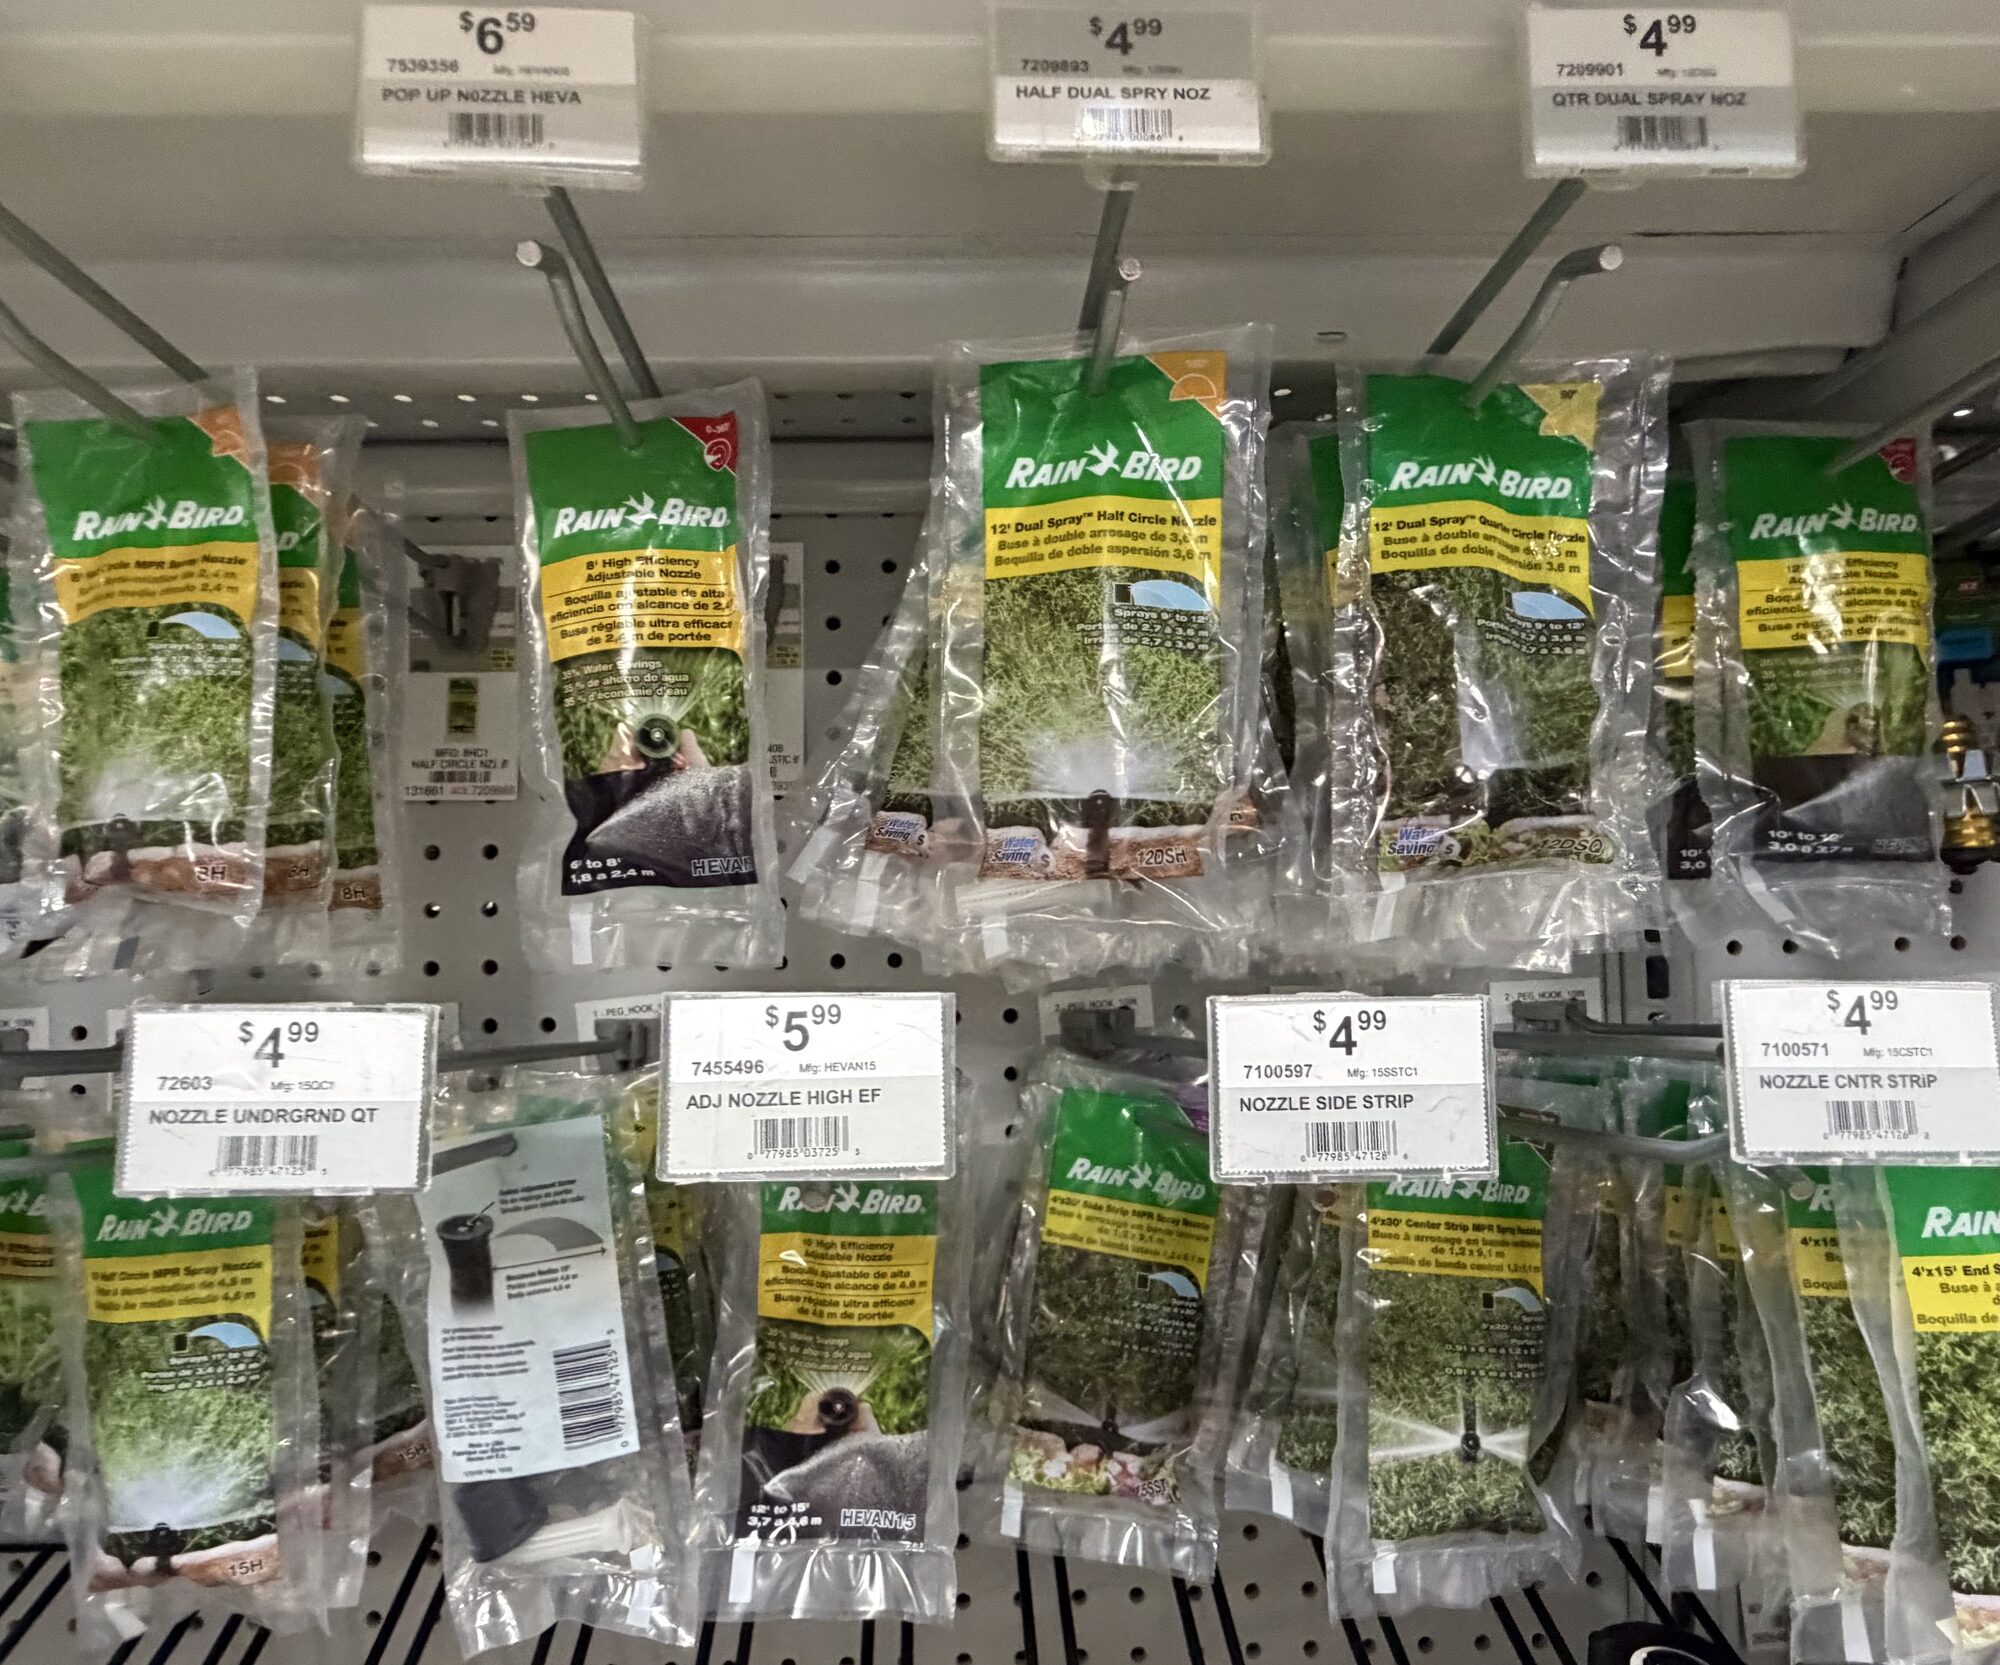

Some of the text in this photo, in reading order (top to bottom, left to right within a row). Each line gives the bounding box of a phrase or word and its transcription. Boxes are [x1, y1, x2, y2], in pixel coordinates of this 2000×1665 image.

[382, 88, 421, 101] POP
[426, 88, 451, 101] UP
[532, 90, 582, 104] HEVA
[1016, 85, 1211, 100] HALF DUAL SPRY NOZ
[1552, 92, 1746, 106] QTR DUAL SPRAY NOZ
[1005, 451, 1202, 489] RAIN BIRD
[1388, 462, 1572, 499] RAIN BIRD
[72, 500, 244, 540] RAIN BIRD
[553, 497, 728, 538] RAIN BIRD
[990, 510, 1166, 535] 12' Dual Half Circle
[1749, 508, 1919, 539] RAIN BIRD
[1374, 519, 1544, 541] 12' Dual Circle
[1384, 529, 1479, 546] Buse double
[998, 529, 1146, 551] Buse double arrosage
[994, 543, 1194, 567] Boquilla doble aspersión 3,6
[1381, 544, 1493, 561] Boquilla doble
[602, 558, 632, 571] High
[586, 569, 655, 583] Adjustable
[565, 590, 612, 606] Boquilla
[551, 599, 689, 622] eficiencia alcance
[1114, 608, 1188, 622] Sprays to
[560, 619, 679, 639] Buse ultra
[1141, 623, 1161, 633] 2,7
[1758, 622, 1793, 633] Buse
[668, 630, 712, 642] portée
[583, 663, 613, 675] Water
[662, 674, 689, 684] agua
[656, 686, 688, 697] d'eau
[1003, 836, 1038, 849] Water
[1388, 842, 1435, 855] Saving
[586, 858, 602, 869] to
[992, 849, 1031, 865] Saving
[611, 869, 637, 880] 2,4
[1761, 1043, 1829, 1056] 7100571
[1863, 1047, 1884, 1058] Mfg:
[692, 1060, 876, 1076] 7455496 Mfg: HEVAN15
[1244, 1064, 1418, 1080] 7100597 Mfg: 15SSTC1
[158, 1076, 213, 1091] 72603
[1760, 1075, 1937, 1089] NOZZLE CNTR STRIP
[686, 1088, 881, 1109] ADJ NOZZLE HIGH EF
[1240, 1094, 1414, 1112] NOZZLE SIDE STRIP
[150, 1108, 380, 1124] NOZZLE UNDRGRND QT
[765, 1149, 799, 1159] 77985
[1066, 1158, 1206, 1200] RAIN BIRD
[1482, 1180, 1531, 1203] BIRD
[860, 1189, 922, 1214] BIRD
[97, 1208, 253, 1241] RAIN BIRD
[1406, 1219, 1441, 1230] Center
[1445, 1222, 1469, 1233] Strip
[1472, 1223, 1494, 1233] MPR
[1372, 1230, 1400, 1240] Buse
[840, 1241, 894, 1251] Efficiency
[890, 1269, 911, 1279] alta
[1912, 1263, 1958, 1277] 4'x15'
[1962, 1264, 1990, 1276] End
[834, 1281, 879, 1291] alcance
[1940, 1282, 1979, 1293] Buse
[774, 1293, 915, 1309] Buse ultra efficace
[857, 1311, 895, 1323] portée
[1917, 1313, 1977, 1327] Boquilla
[774, 1502, 811, 1514] to 15'
[747, 1516, 772, 1528] 3,7
[840, 1509, 916, 1530] HEVAN15
[228, 1560, 264, 1577] 15H
